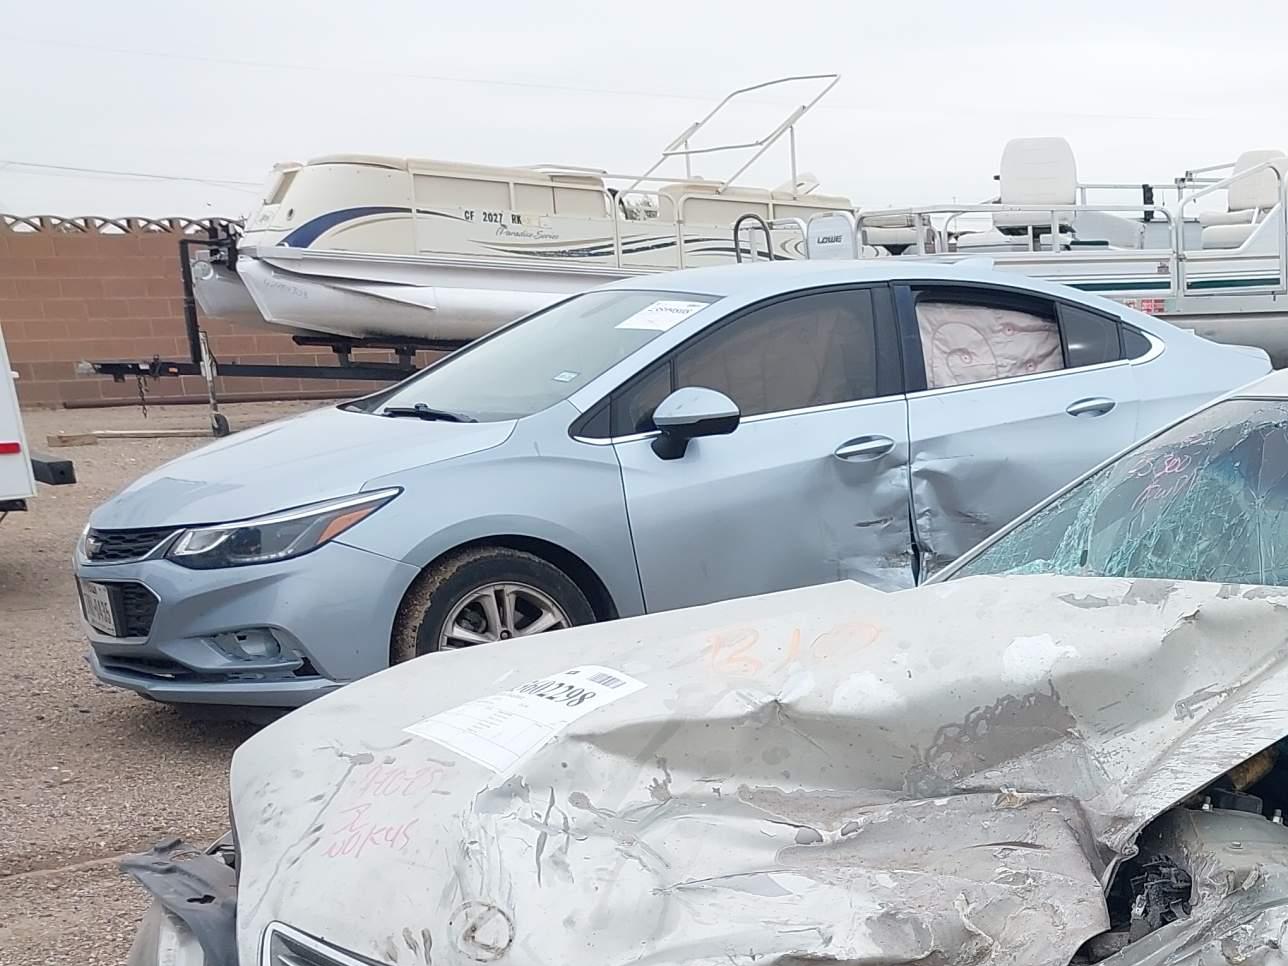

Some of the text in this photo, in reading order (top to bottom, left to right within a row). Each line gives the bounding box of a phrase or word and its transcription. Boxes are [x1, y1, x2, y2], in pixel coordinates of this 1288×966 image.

[482, 211, 504, 224] 2027
[511, 213, 523, 225] RK
[816, 234, 843, 244] LOWE
